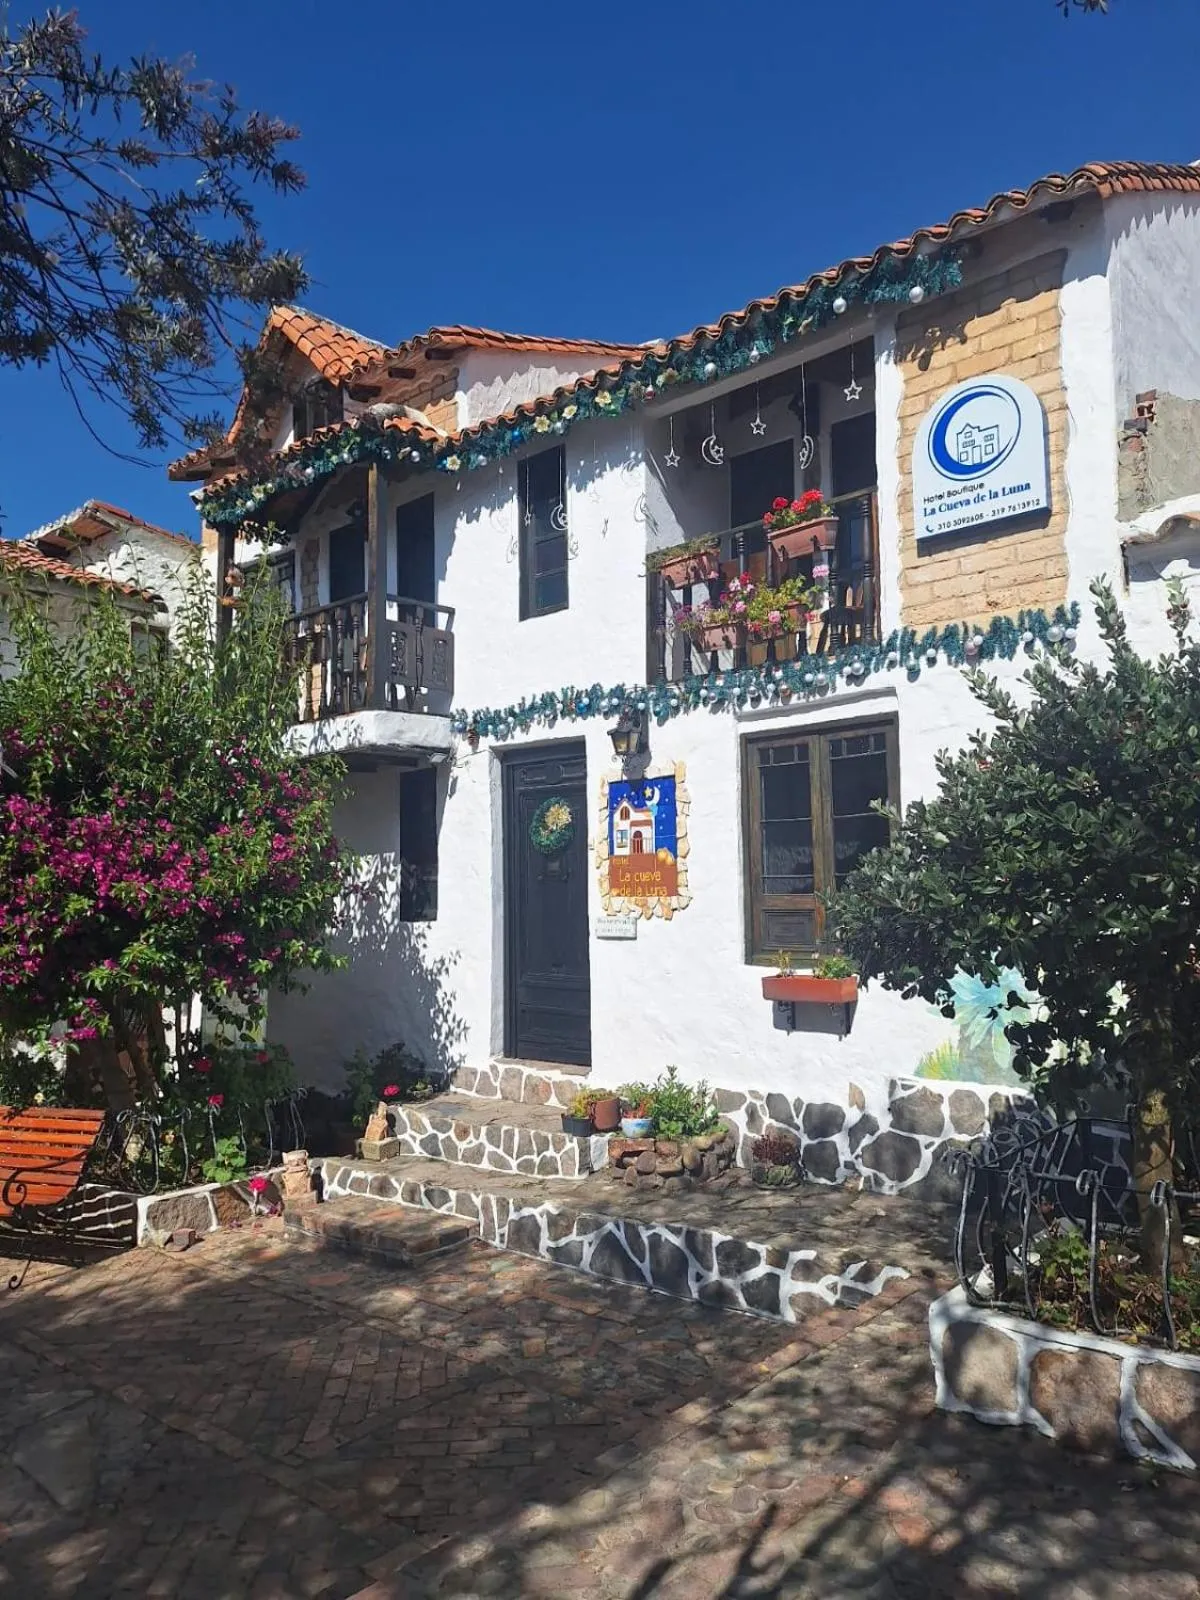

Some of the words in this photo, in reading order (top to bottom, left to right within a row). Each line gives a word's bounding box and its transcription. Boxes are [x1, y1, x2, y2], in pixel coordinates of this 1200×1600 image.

[923, 492, 945, 504] Hotel
[946, 482, 985, 498] Boutique
[923, 507, 936, 517] La
[939, 498, 971, 513] Cueva
[973, 493, 987, 504] de
[989, 490, 999, 500] la
[1001, 482, 1031, 497] Luna
[938, 521, 952, 531] 310
[991, 507, 1005, 517] 319
[619, 868, 631, 882] La
[634, 871, 661, 882] cueva
[620, 884, 631, 896] de
[634, 883, 642, 896] la
[646, 883, 668, 896] Luna
